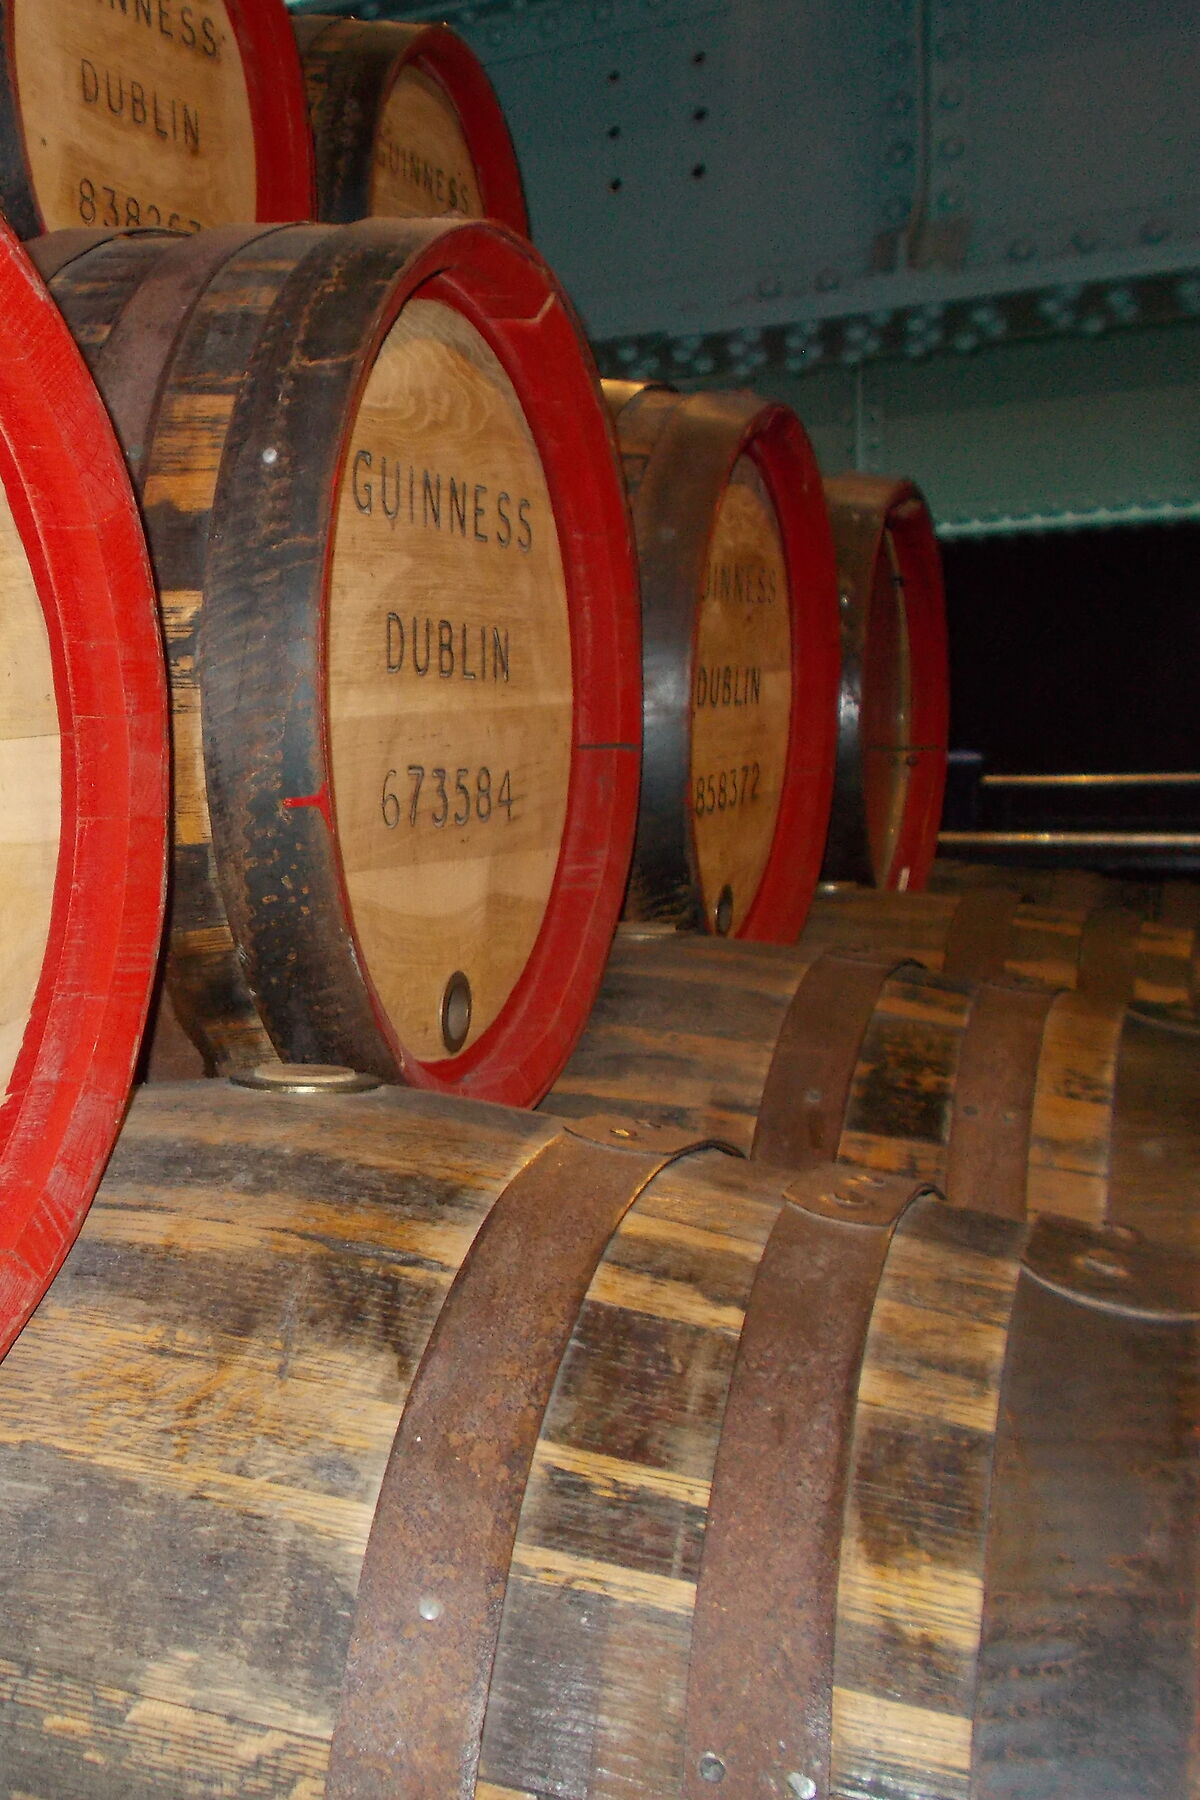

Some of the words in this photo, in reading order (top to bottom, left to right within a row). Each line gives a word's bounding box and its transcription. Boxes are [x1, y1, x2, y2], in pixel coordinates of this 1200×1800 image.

[80, 59, 199, 146] DUBLIN
[352, 449, 533, 553] GUINNESS
[386, 611, 510, 682] DUBLIN
[697, 666, 761, 709] DUBLIN
[381, 765, 515, 830] 673584
[695, 762, 760, 817] 858372
